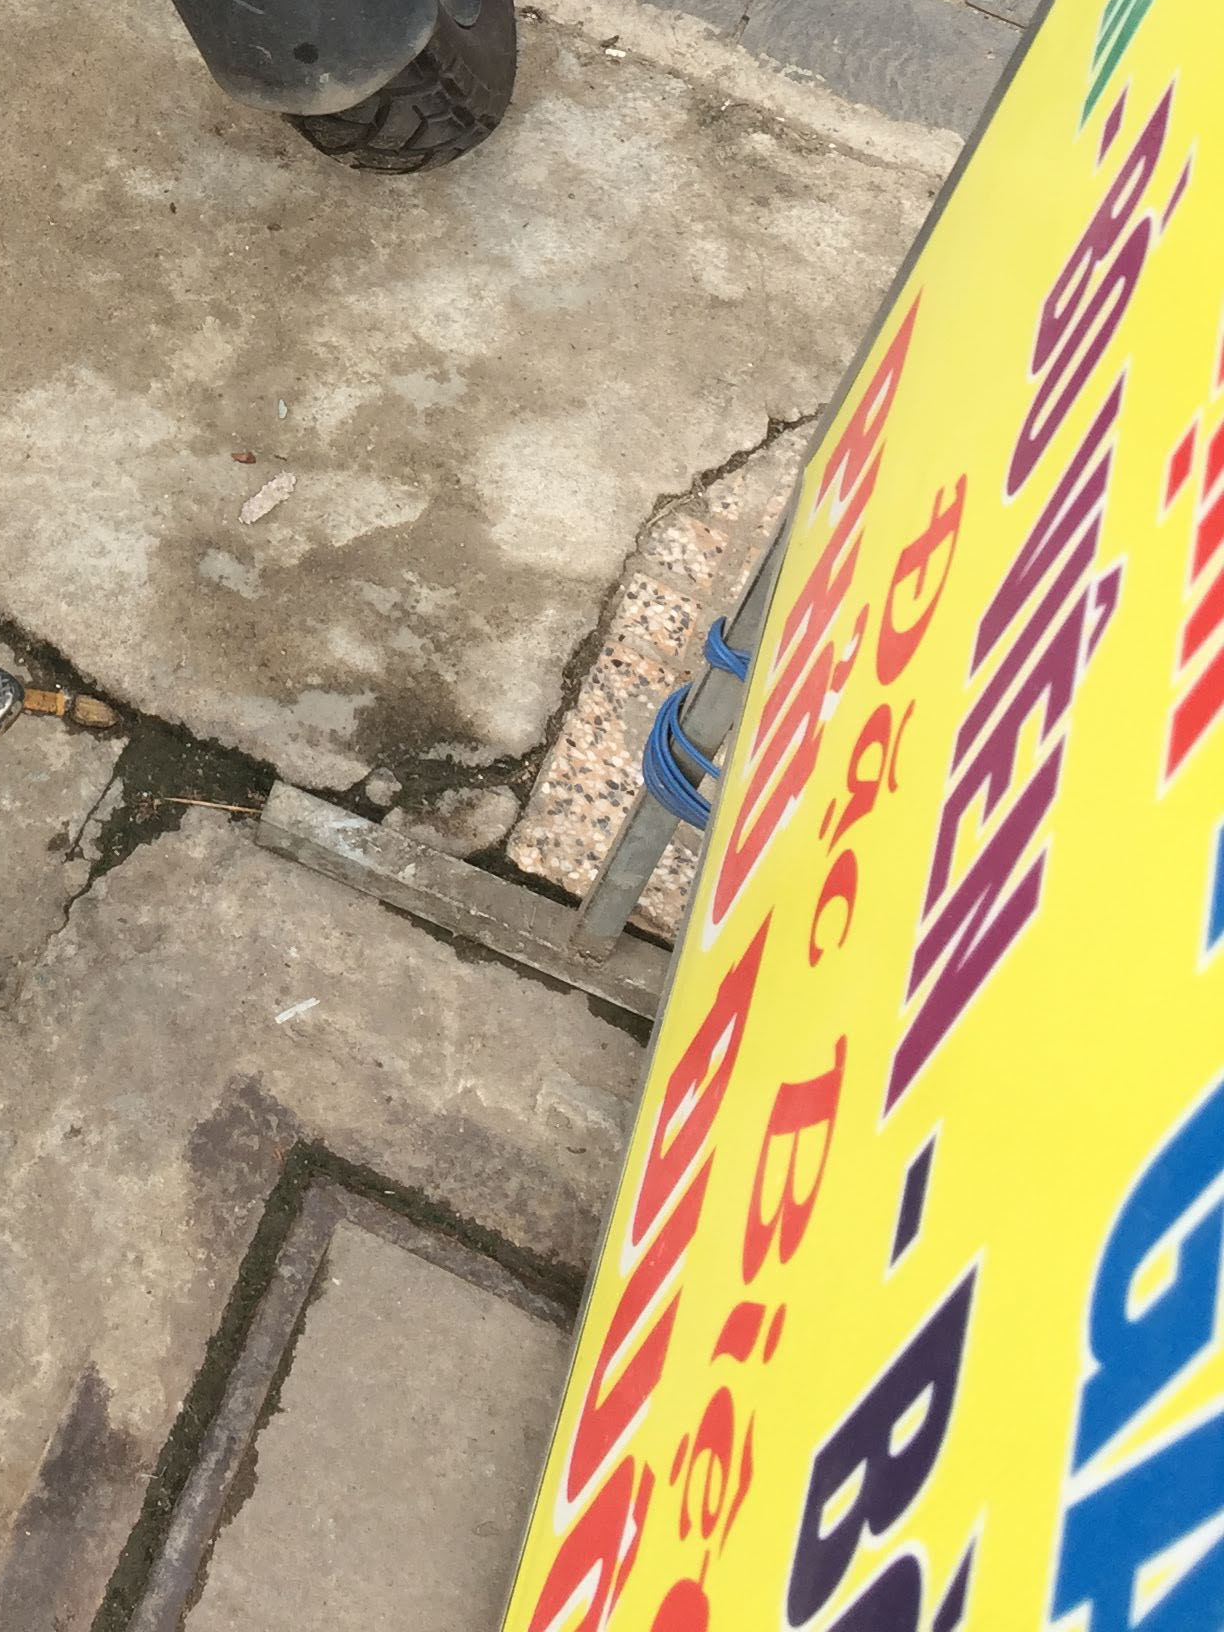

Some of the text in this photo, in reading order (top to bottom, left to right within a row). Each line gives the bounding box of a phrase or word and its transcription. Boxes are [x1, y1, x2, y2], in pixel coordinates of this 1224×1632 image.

[712, 289, 922, 927] PHỞ
[809, 473, 966, 968] Đặc
[884, 373, 1126, 1117] VIÊN
